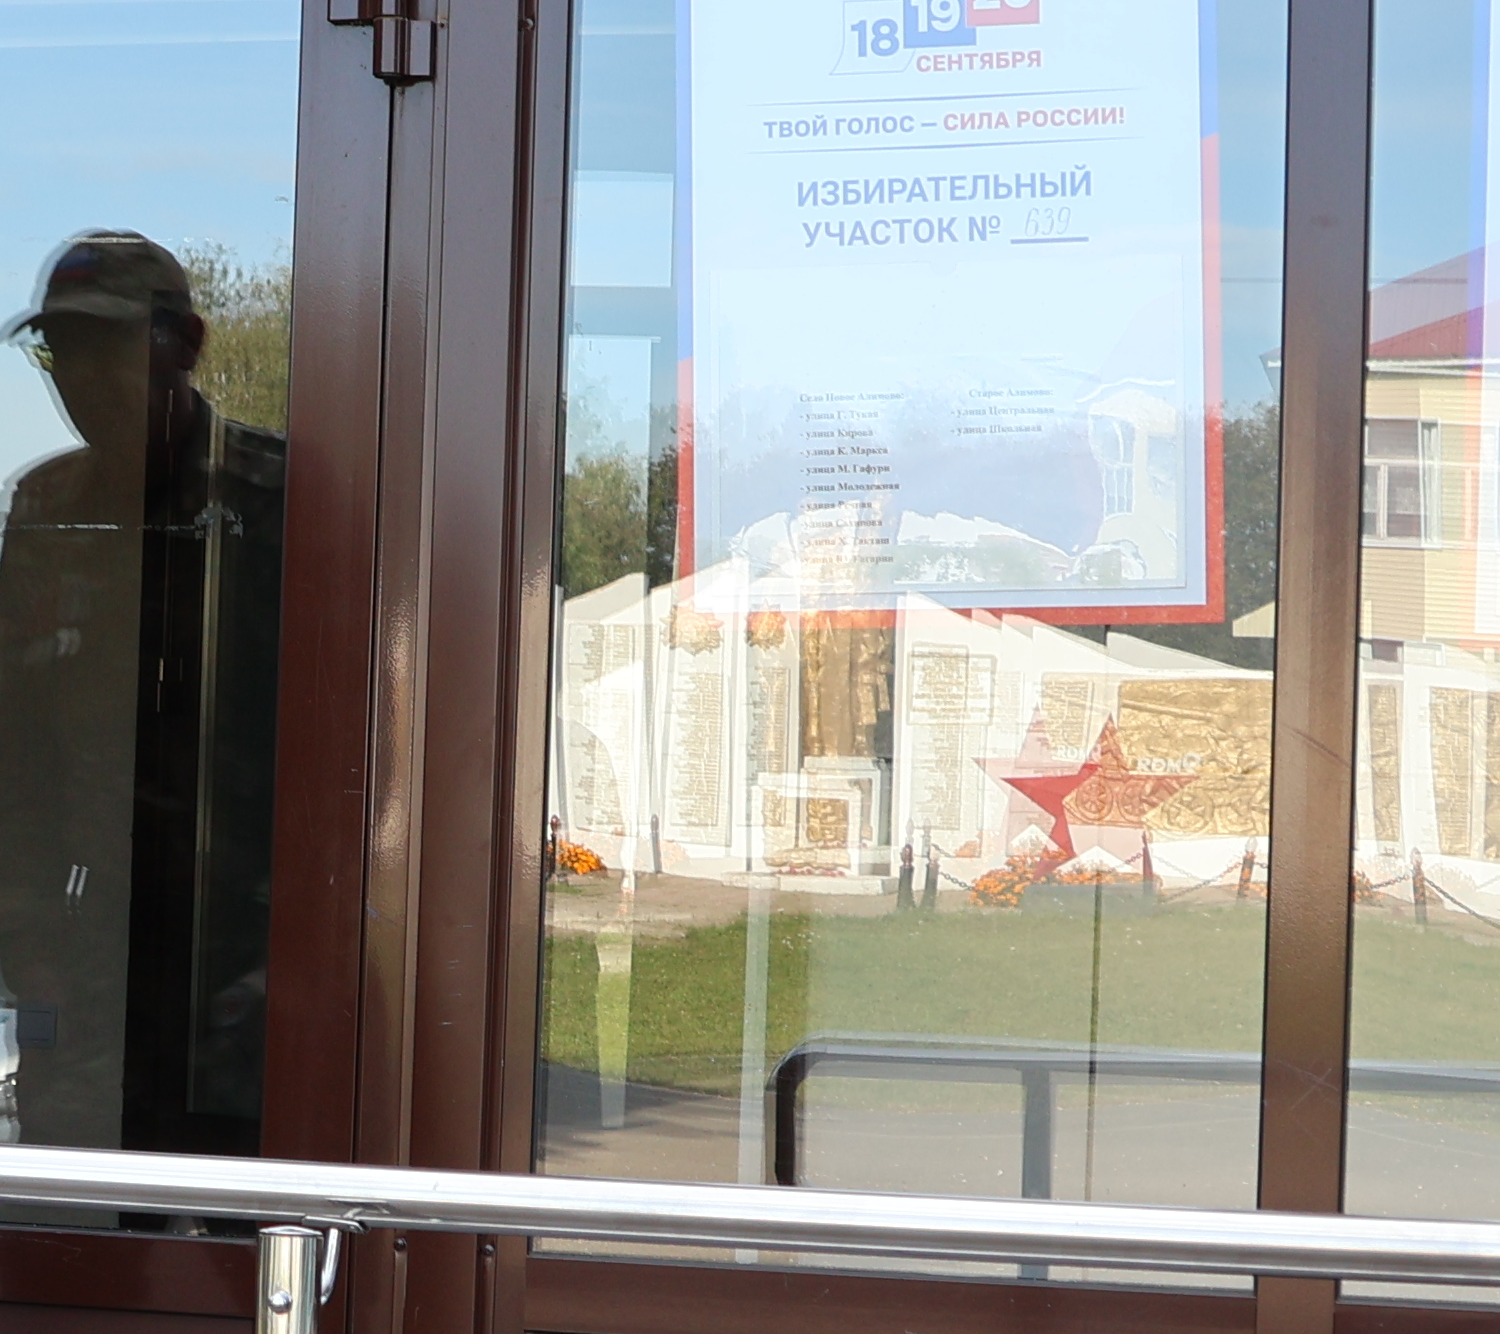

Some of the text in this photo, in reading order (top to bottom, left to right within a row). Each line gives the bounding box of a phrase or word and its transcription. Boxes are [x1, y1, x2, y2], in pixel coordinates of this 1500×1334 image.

[851, 18, 900, 58] 18
[916, 50, 1042, 73] СЕНТЯБРЯ
[763, 115, 828, 138] ТВОЙ
[835, 116, 915, 137] ГОЛОС
[943, 111, 1010, 131] СИЛА
[1016, 106, 1125, 127] РОССИИ!
[797, 163, 1093, 208] ИЗБИРАТЕЛЬНЫЙ
[801, 215, 1001, 248] УЧАСТОК №
